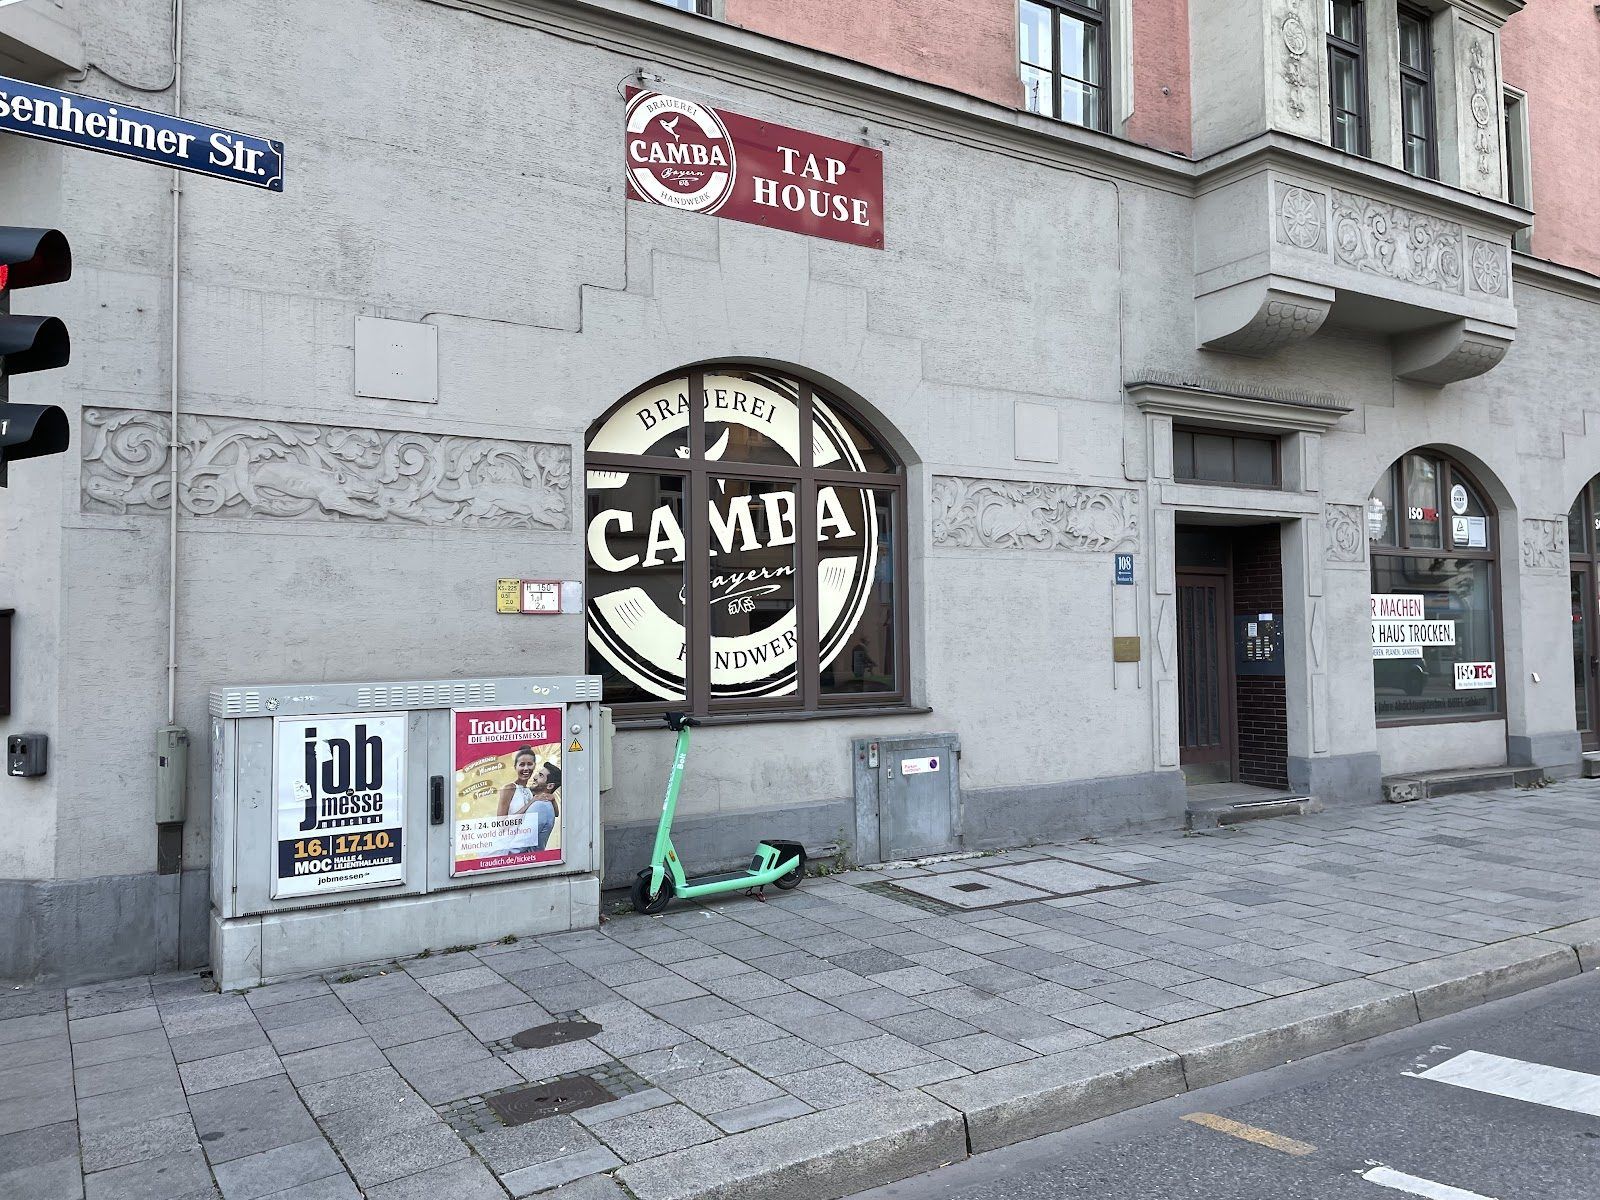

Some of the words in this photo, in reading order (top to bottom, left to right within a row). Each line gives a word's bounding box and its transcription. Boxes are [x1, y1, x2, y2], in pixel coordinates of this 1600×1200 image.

[646, 99, 697, 116] BRAUEREI
[209, 132, 266, 176] Str.
[630, 139, 728, 167] CAMBA
[661, 167, 704, 178] Bayern
[777, 145, 846, 185] TAP
[661, 191, 710, 205] HANDWERK
[752, 176, 870, 227] HOUSE
[1117, 556, 1131, 570] 108
[679, 565, 797, 606] ayern
[1380, 598, 1421, 617] MACHEN
[1379, 624, 1406, 643] HAUS
[1408, 624, 1454, 642] TROCKEN.
[1457, 664, 1493, 679] ISOTEC
[469, 713, 546, 734] TrauDich!
[485, 732, 544, 742] HOCHZEITSMESSE
[677, 753, 686, 769] Bolt
[300, 724, 382, 831] job
[322, 792, 382, 817] messe
[478, 822, 489, 830] 24.
[491, 818, 523, 828] OKTOBER
[461, 833, 476, 842] MTC
[477, 829, 497, 840] world
[498, 828, 506, 838] of
[507, 826, 532, 837] fashion
[294, 839, 328, 858] 16.
[335, 831, 395, 854] 17.10.
[461, 841, 493, 851] München
[294, 858, 332, 875] MOC
[333, 856, 394, 870] LILIENTHALALLEE
[334, 855, 357, 864] HALLE
[357, 854, 363, 862] 4
[480, 854, 537, 868] traudich.de/tickets
